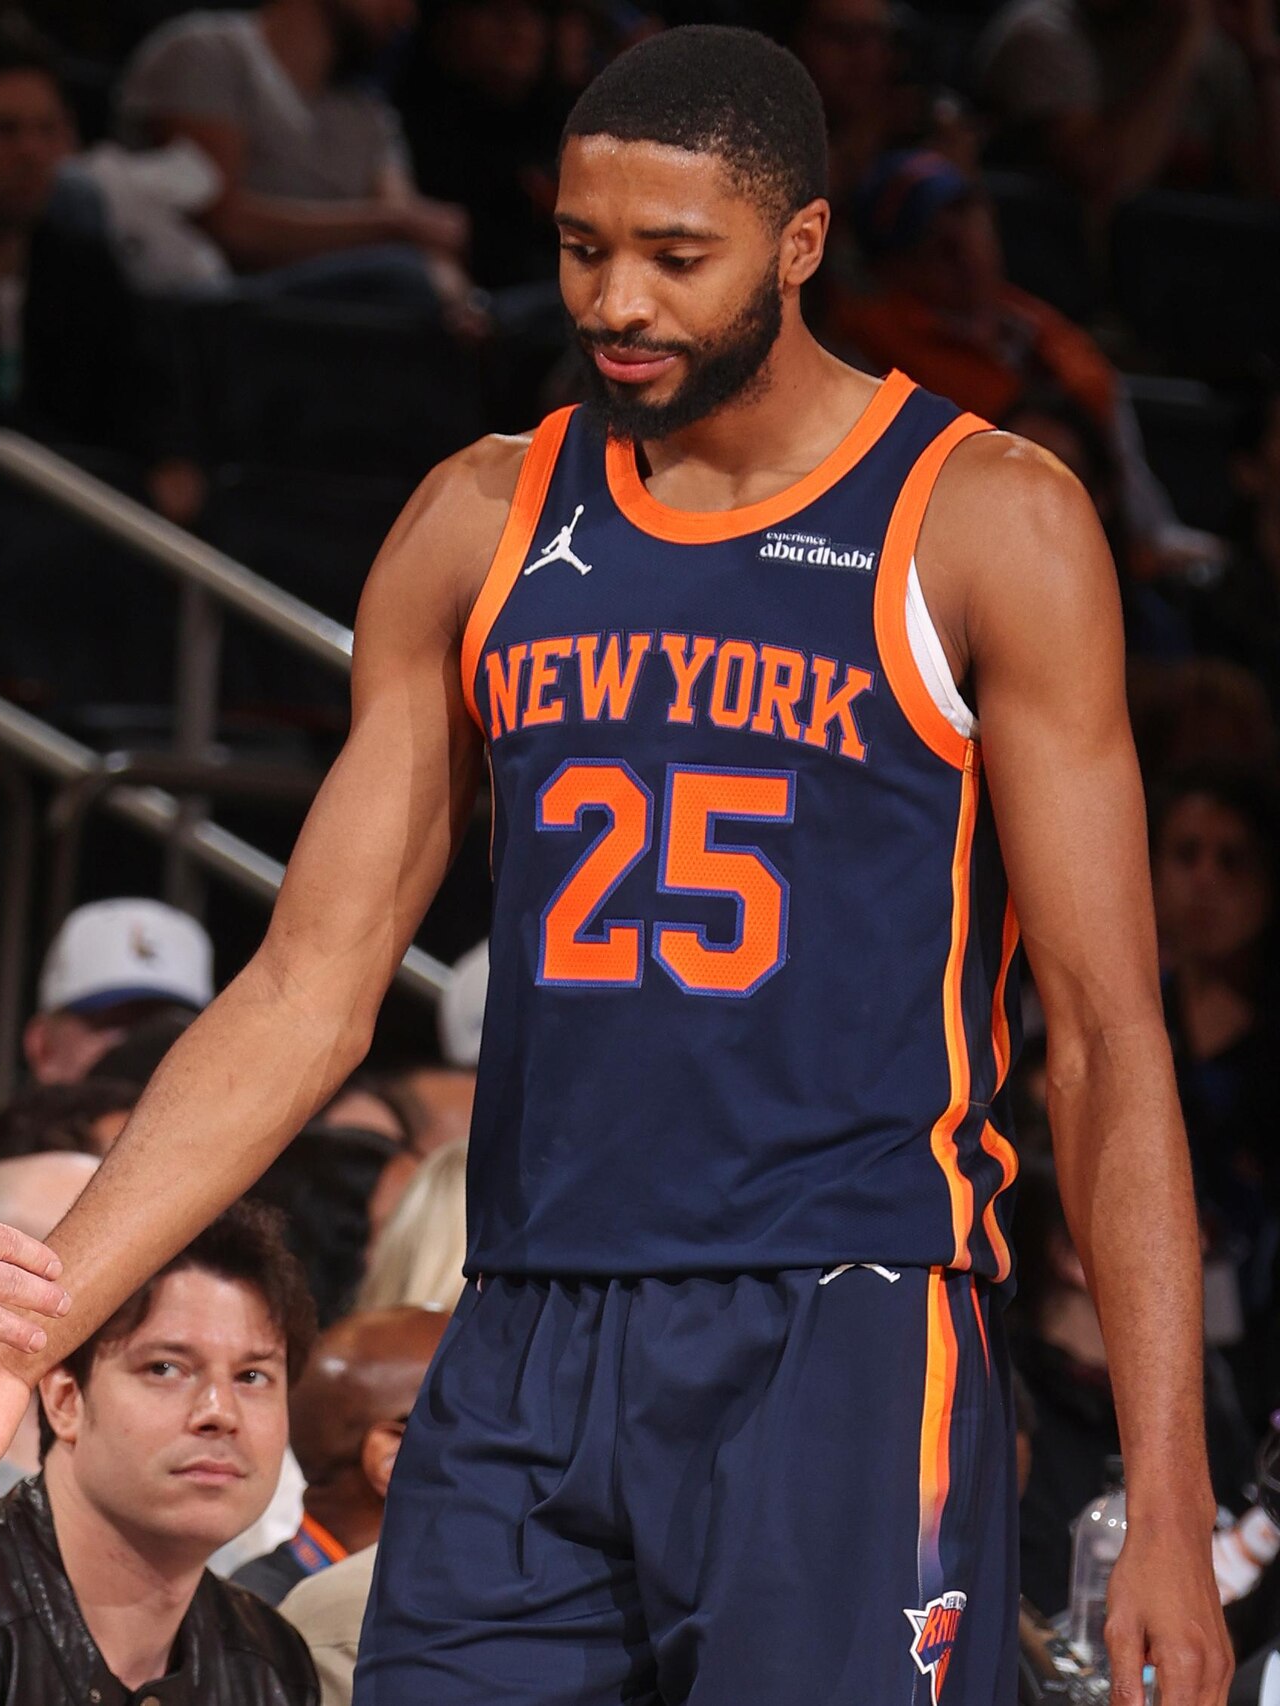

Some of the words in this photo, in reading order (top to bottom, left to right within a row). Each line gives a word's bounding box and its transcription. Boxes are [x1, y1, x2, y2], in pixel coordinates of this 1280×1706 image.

[759, 541, 804, 562] abu
[807, 546, 875, 570] dhabi
[766, 531, 827, 545] experience
[484, 630, 654, 743] NEW
[659, 631, 876, 764] YORK
[535, 757, 797, 998] 25
